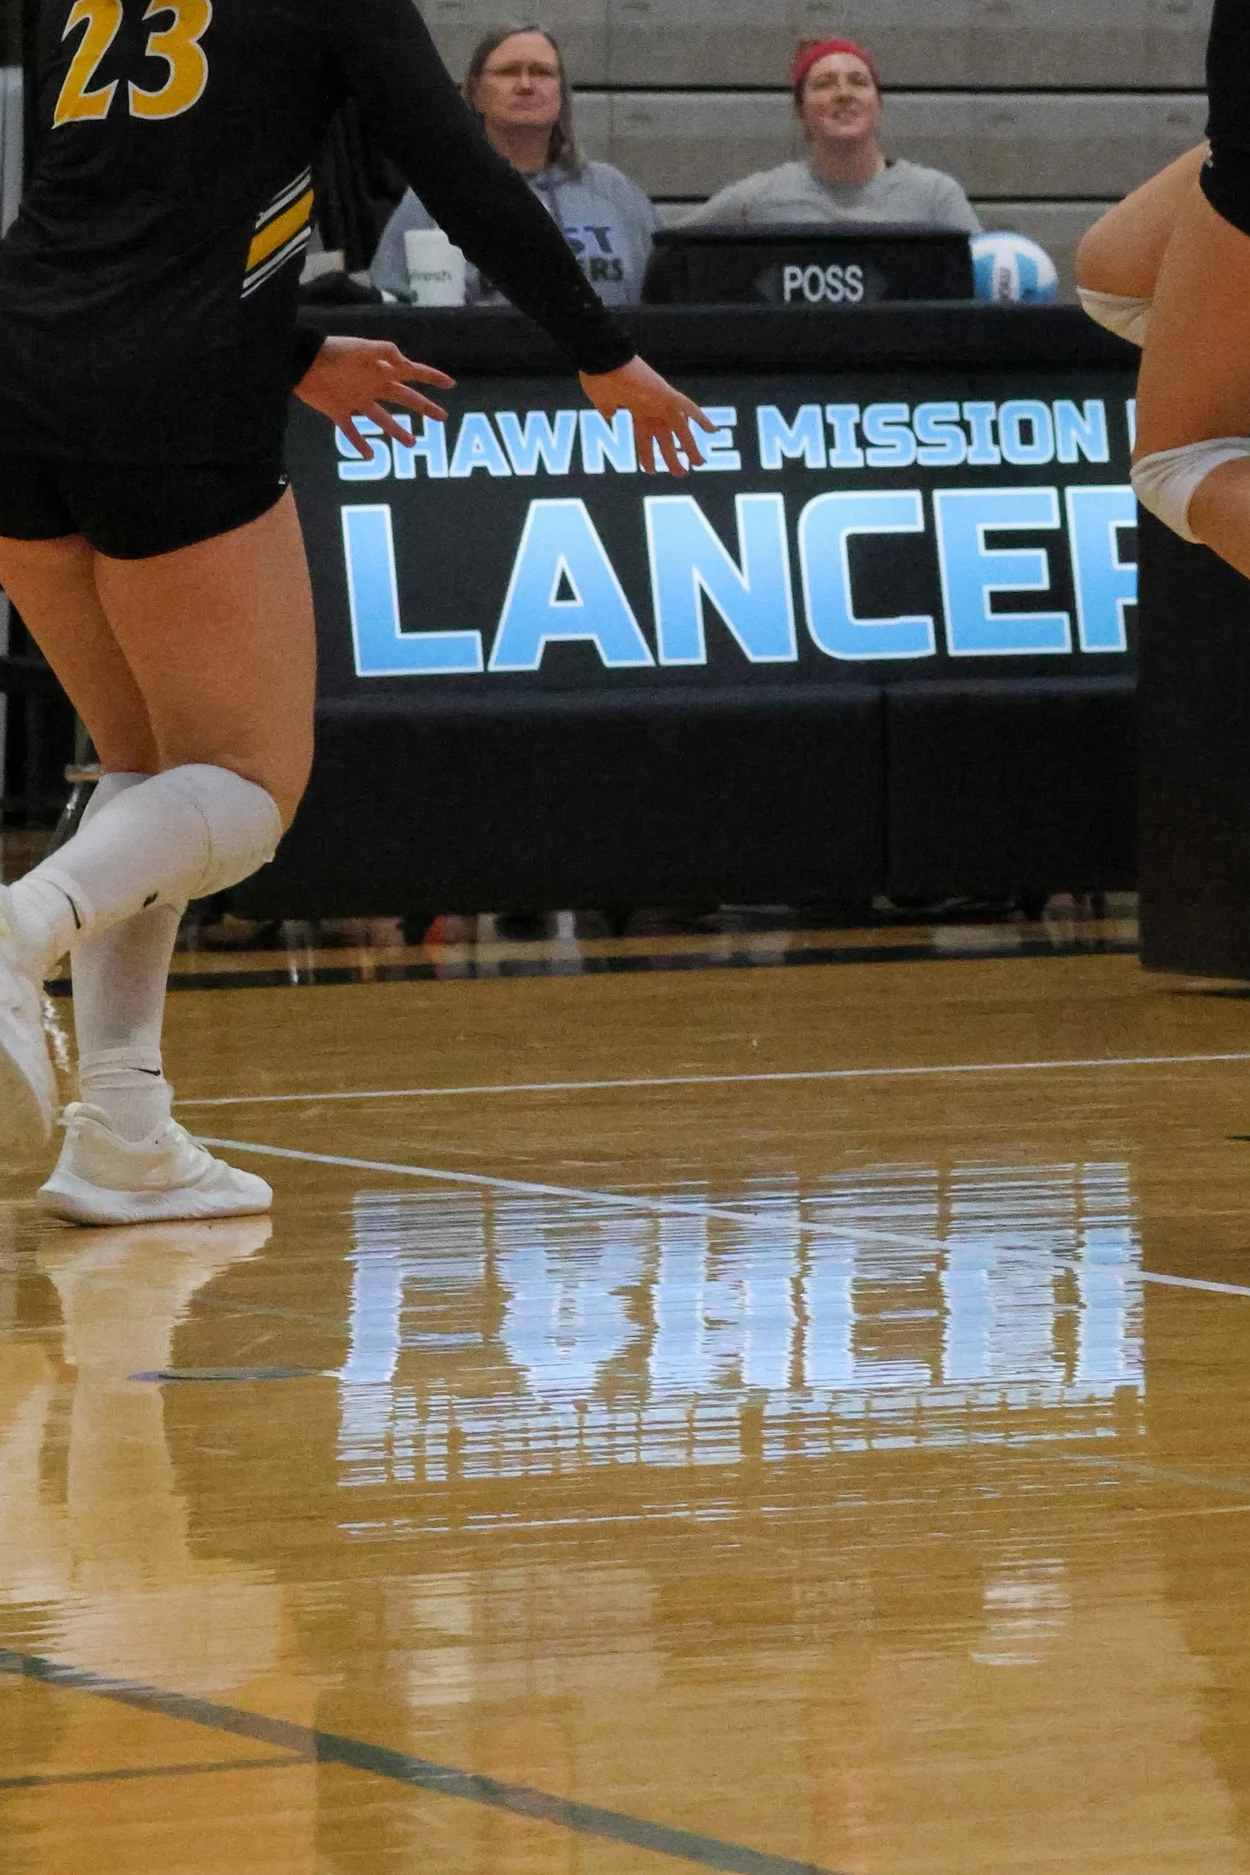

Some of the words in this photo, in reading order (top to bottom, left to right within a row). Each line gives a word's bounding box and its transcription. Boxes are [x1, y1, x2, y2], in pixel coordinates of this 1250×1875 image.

[783, 264, 864, 303] POSS
[334, 404, 742, 482] SHAWNE
[757, 399, 1109, 471] MISSION
